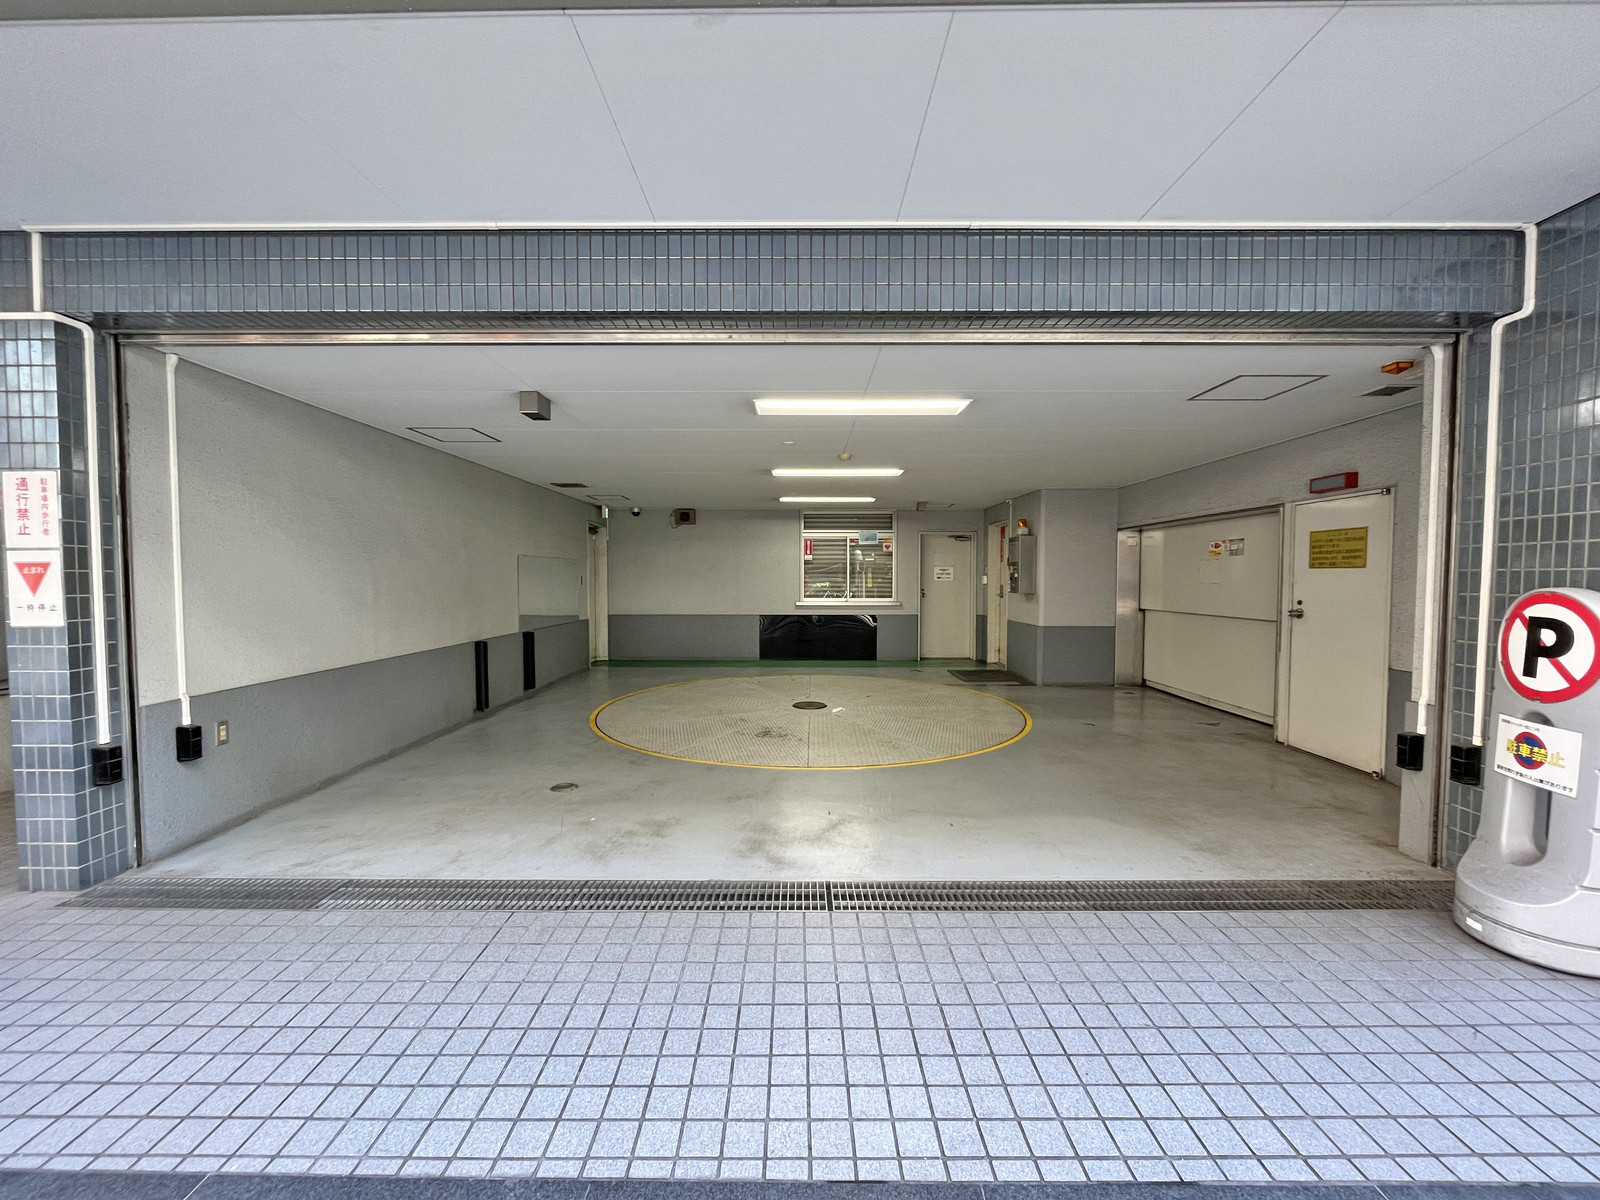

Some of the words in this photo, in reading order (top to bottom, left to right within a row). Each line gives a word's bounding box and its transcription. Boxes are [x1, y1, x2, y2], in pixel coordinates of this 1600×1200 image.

[15, 477, 31, 536] 通行禁止
[22, 566, 46, 575] 止まれ
[16, 603, 58, 612] 一時停止
[1523, 616, 1575, 678] P
[1506, 738, 1566, 769] 駐車禁止
